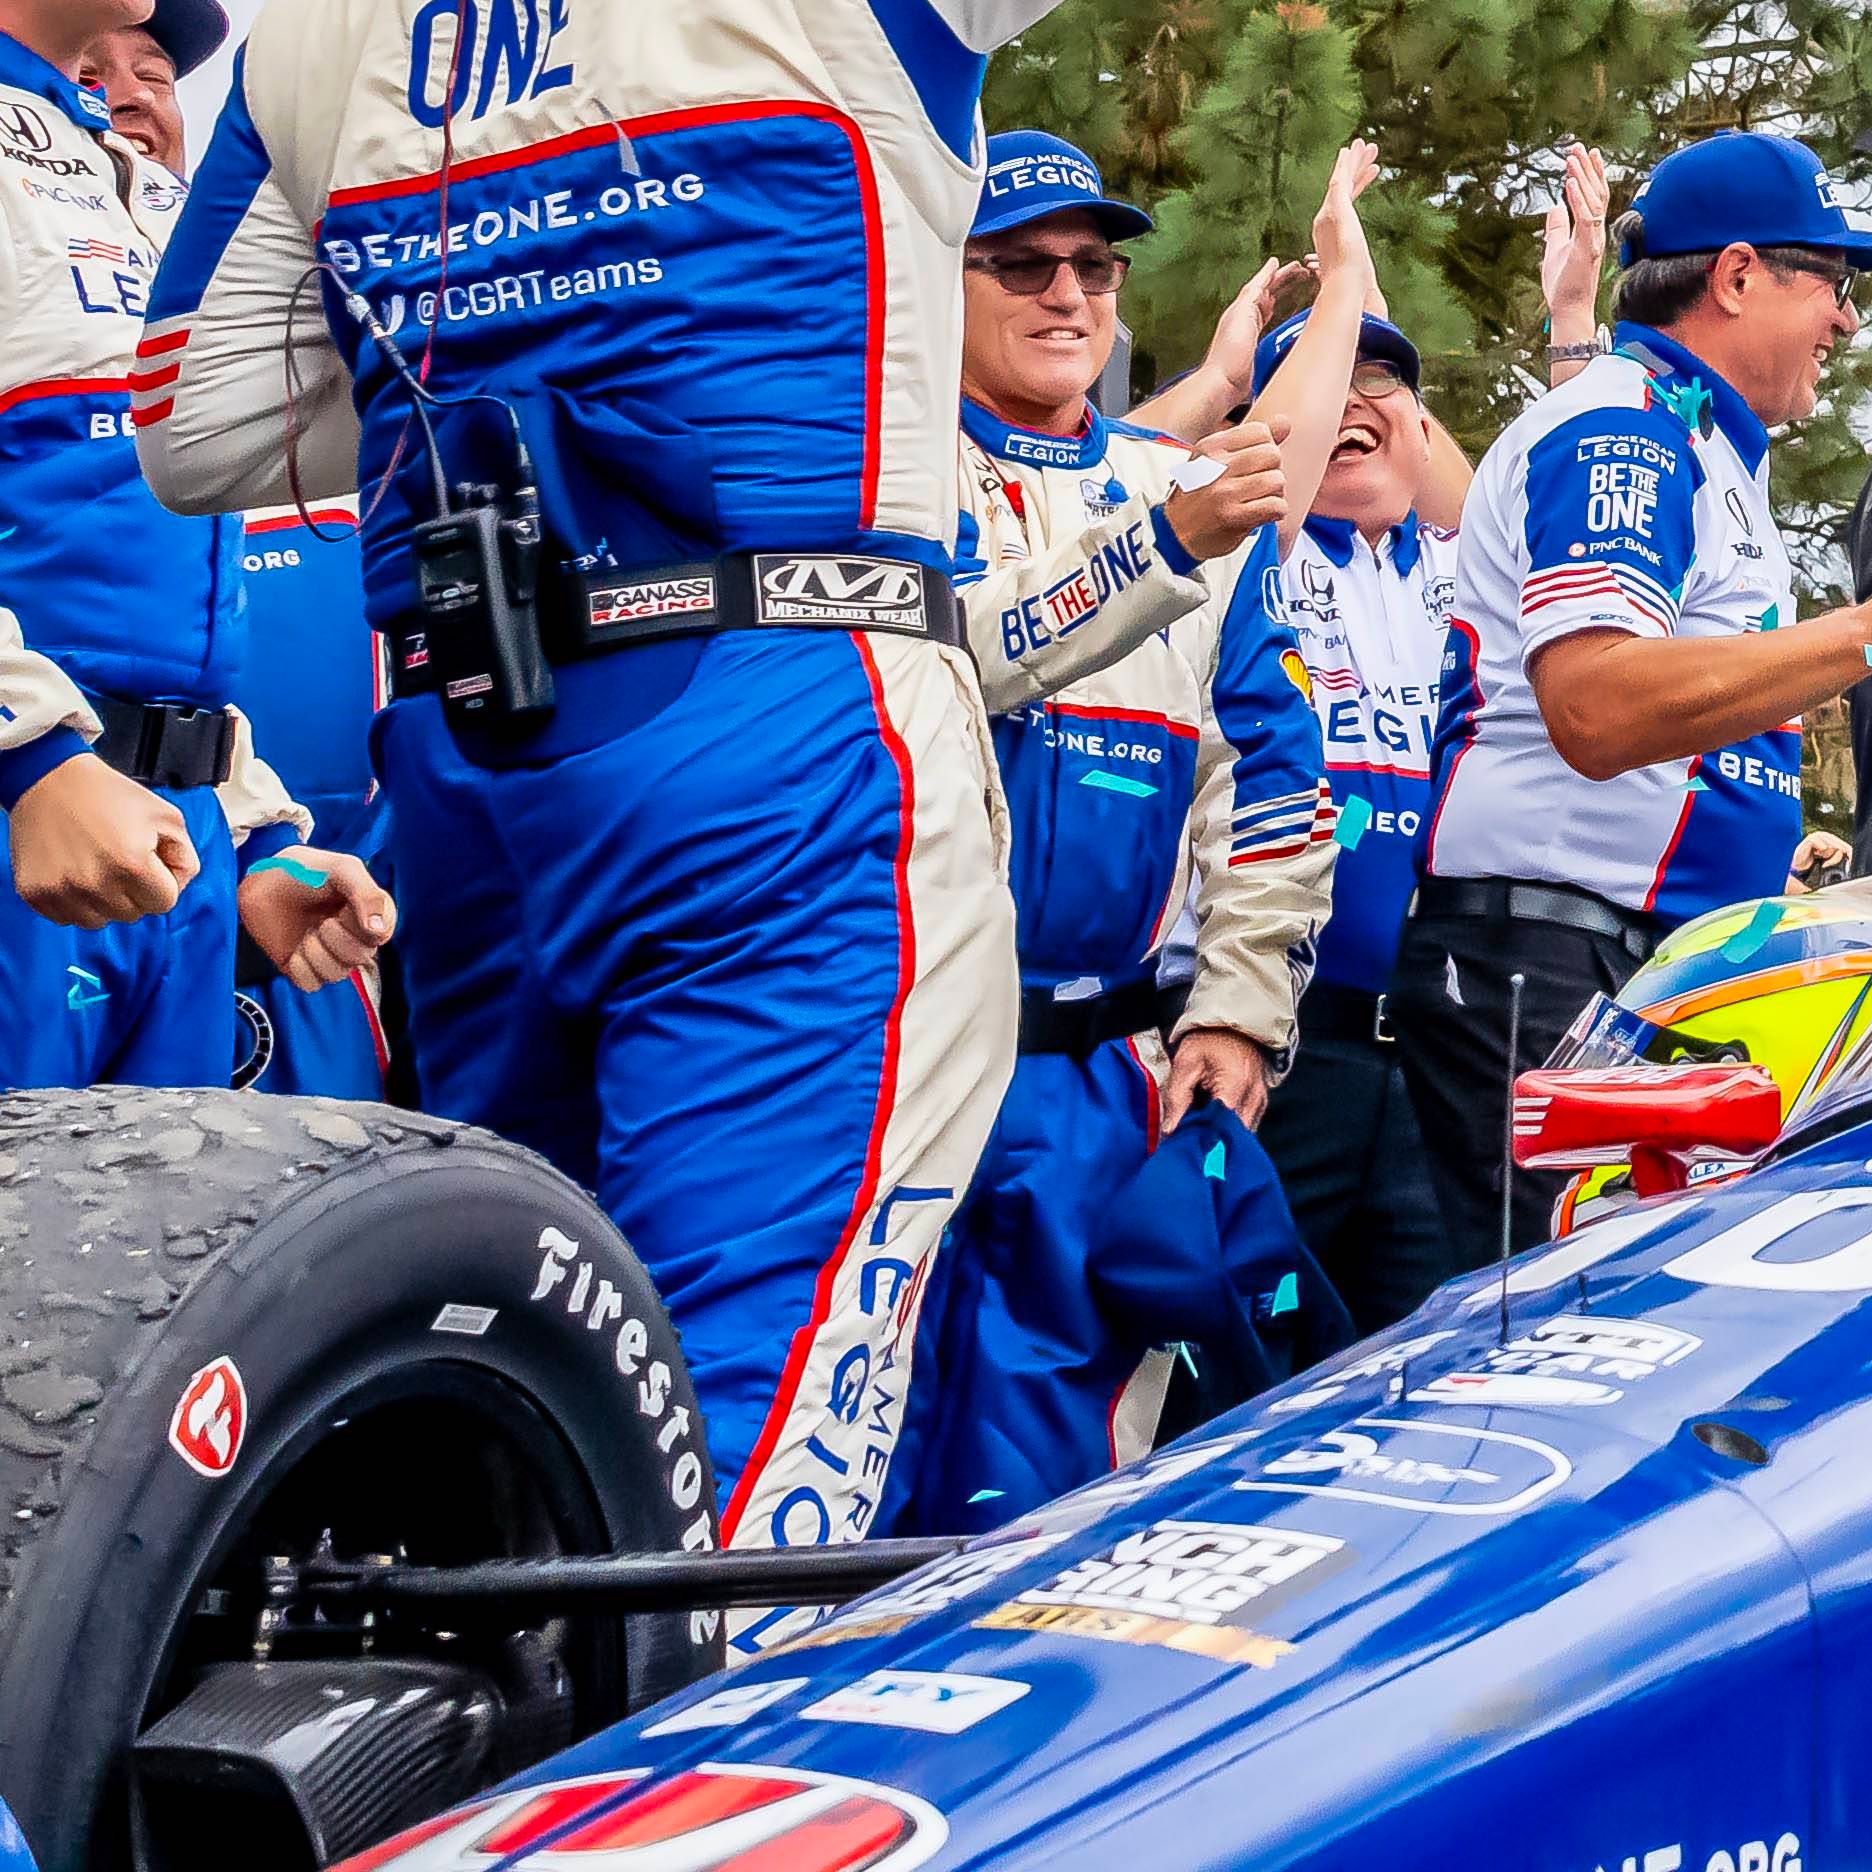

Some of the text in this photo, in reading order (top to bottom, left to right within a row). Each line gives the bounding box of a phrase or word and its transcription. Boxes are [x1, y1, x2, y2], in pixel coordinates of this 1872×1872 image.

[988, 165, 1100, 198] LEGION
[324, 173, 705, 274] BETHEONE.ORG
[416, 257, 664, 327] @CGRTeams
[1004, 439, 1082, 465] LEGION
[1576, 442, 1677, 476] LEGION
[1606, 434, 1677, 459] AMERICAN
[1589, 463, 1660, 495] BE THE
[1586, 492, 1659, 540] ONE
[1589, 536, 1664, 567] PNC BANK
[612, 578, 713, 608] GANASSI
[1000, 519, 1153, 662] BE THE ONE
[592, 595, 711, 624] RACING
[766, 598, 923, 627] MECHANIX WEAR
